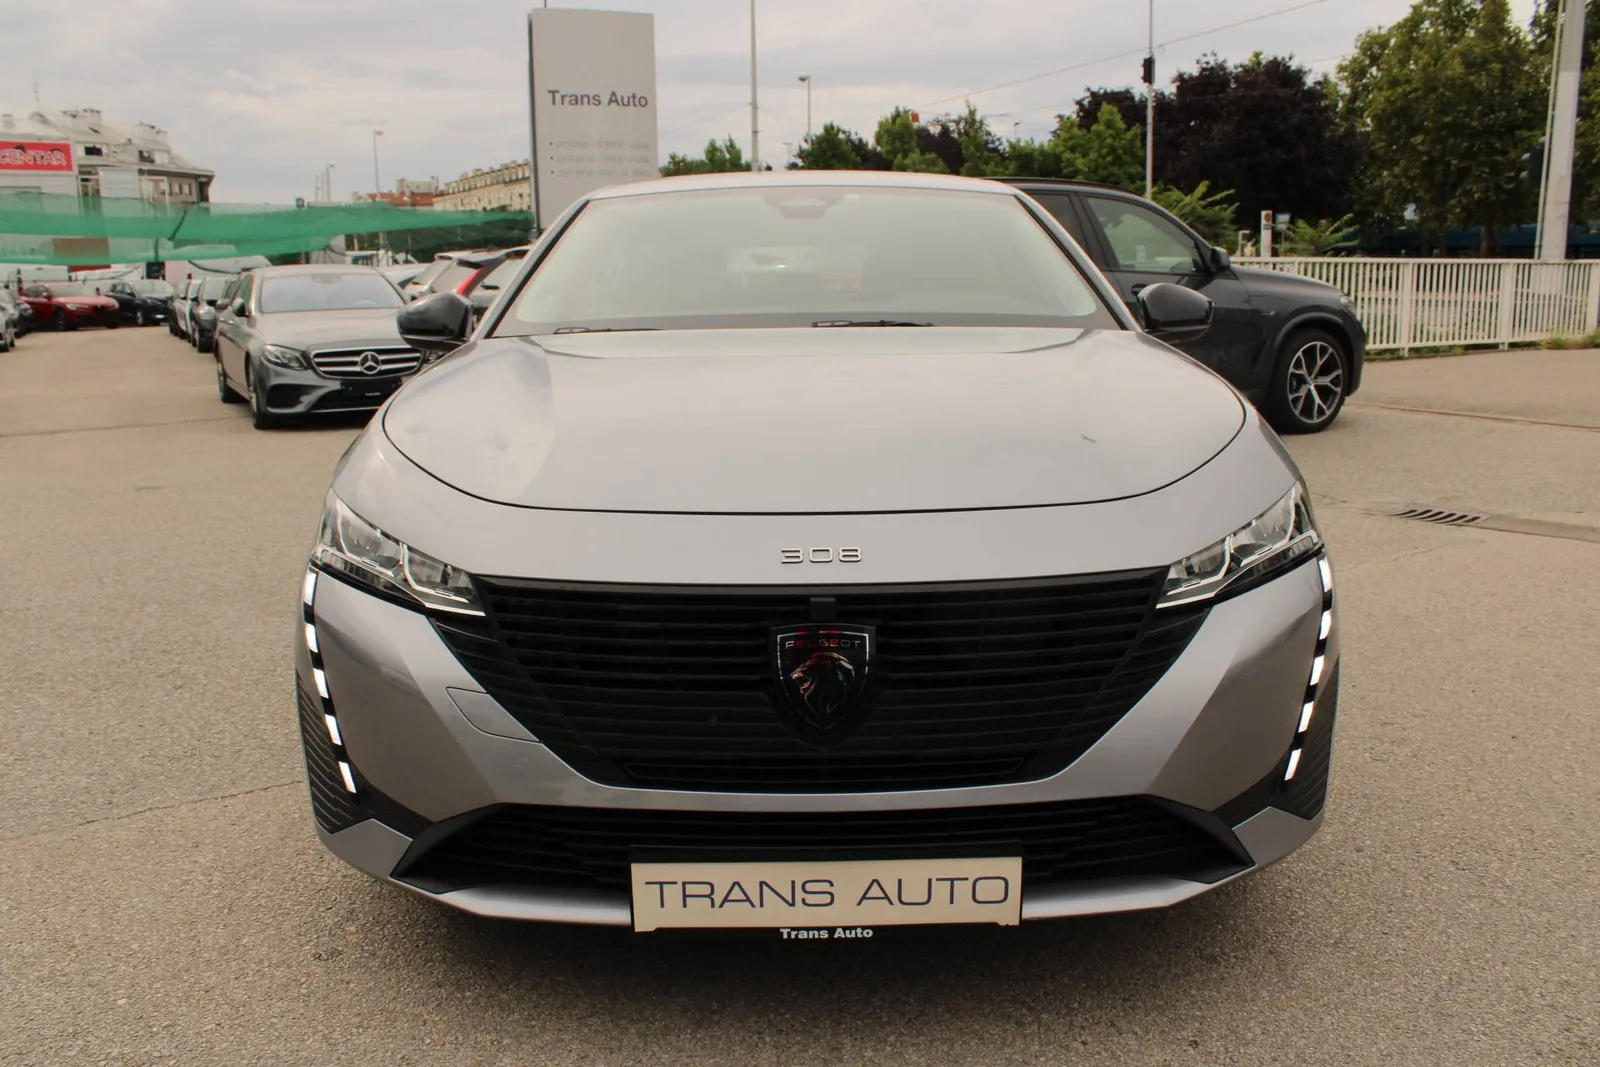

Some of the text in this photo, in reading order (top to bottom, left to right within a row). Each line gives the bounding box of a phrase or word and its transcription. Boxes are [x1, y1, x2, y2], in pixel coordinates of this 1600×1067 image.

[547, 89, 649, 108] Trans Auto
[781, 547, 862, 564] 308
[785, 639, 861, 649] PEUGEOT
[645, 875, 1009, 909] TRANS AUTO
[780, 927, 874, 939] Trans Auto
